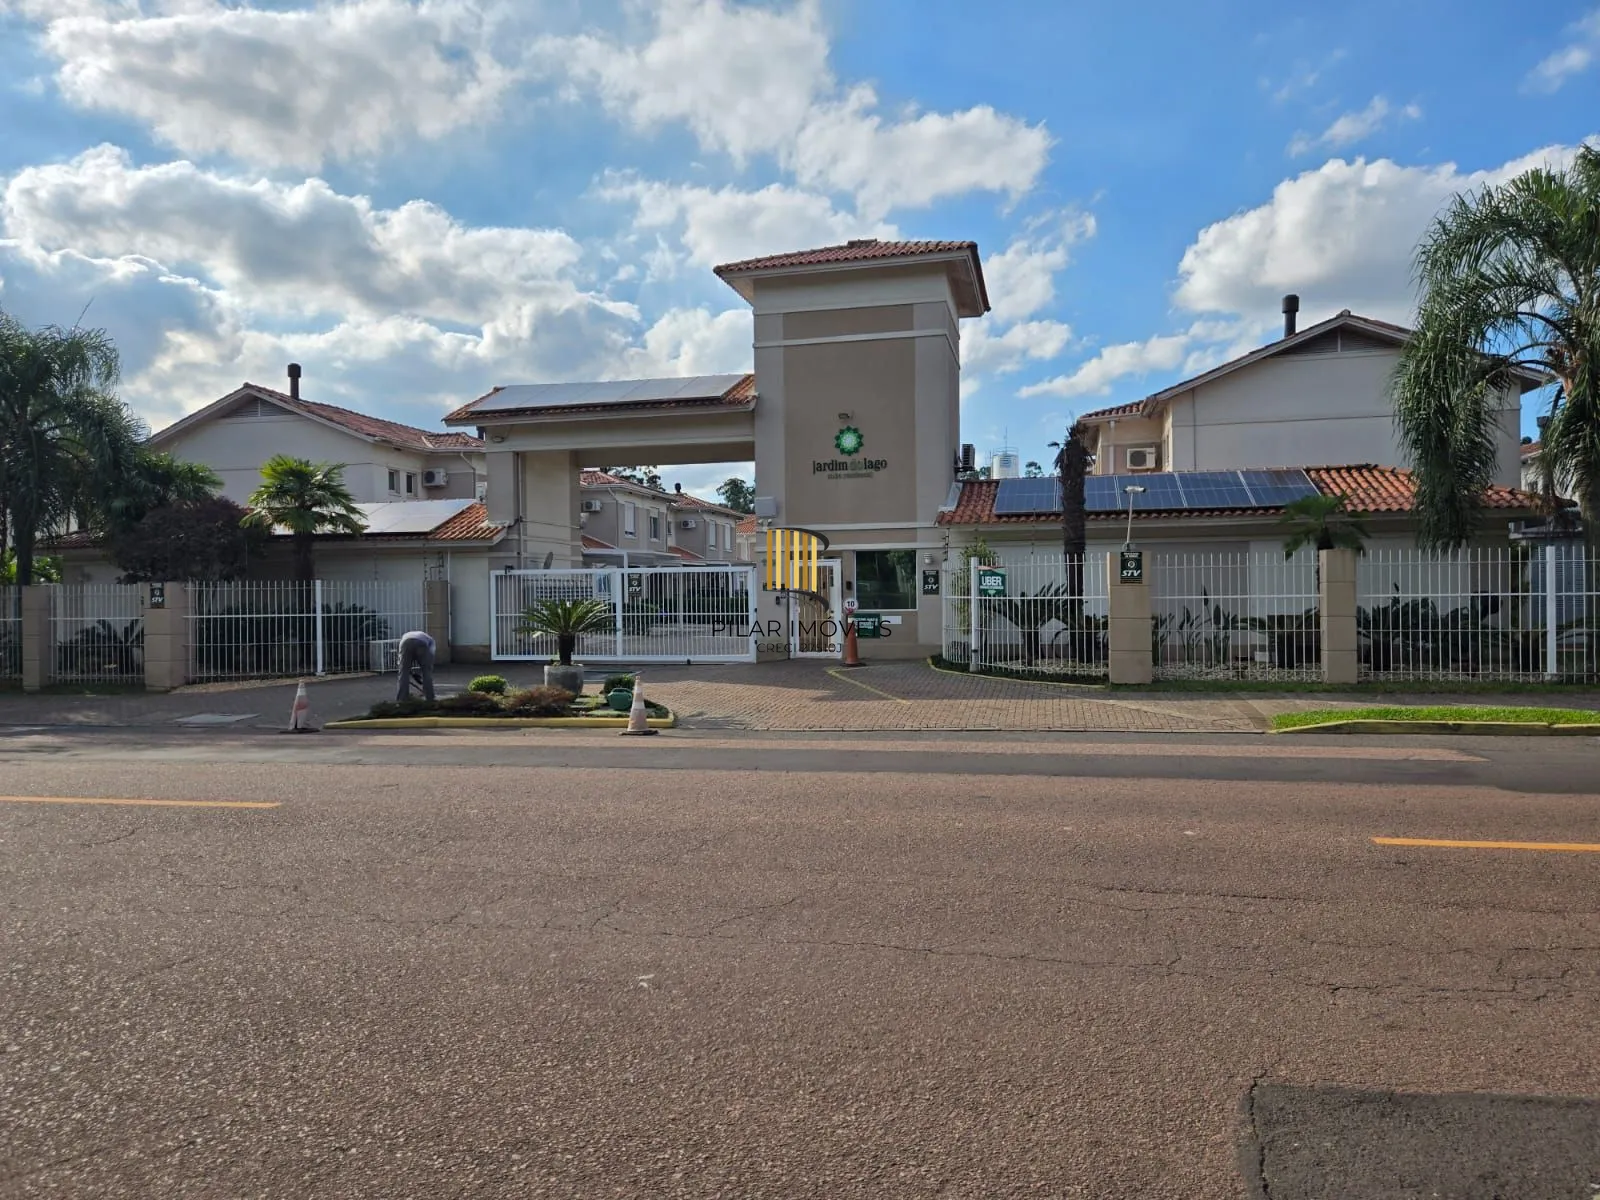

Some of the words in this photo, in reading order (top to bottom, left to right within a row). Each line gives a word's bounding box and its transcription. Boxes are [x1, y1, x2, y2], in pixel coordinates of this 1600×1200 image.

[812, 459, 848, 475] jardim
[863, 457, 888, 472] lago
[981, 575, 1002, 586] UBER
